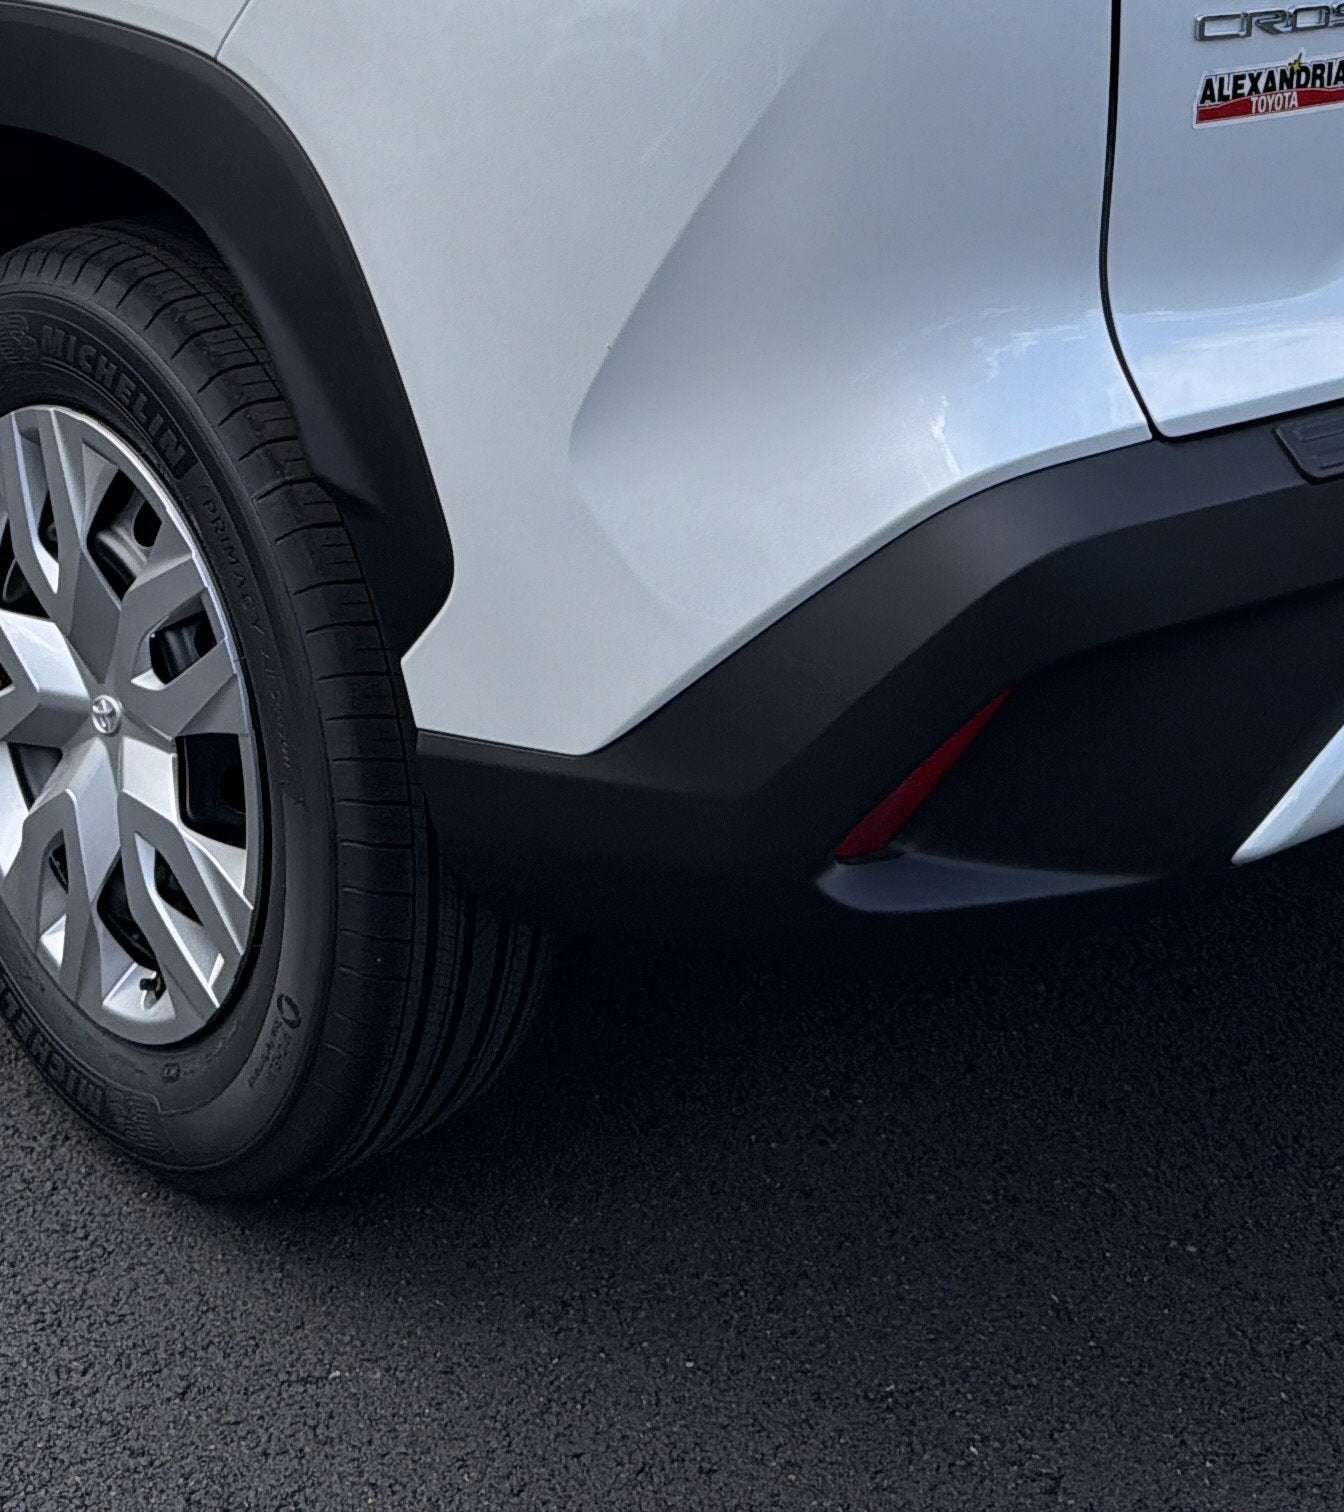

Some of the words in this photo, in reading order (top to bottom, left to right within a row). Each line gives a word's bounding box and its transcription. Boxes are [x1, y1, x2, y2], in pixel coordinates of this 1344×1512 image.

[1250, 91, 1299, 114] TOYOTA
[40, 324, 187, 468] MICHELIN
[201, 498, 266, 637] PRIMACY
